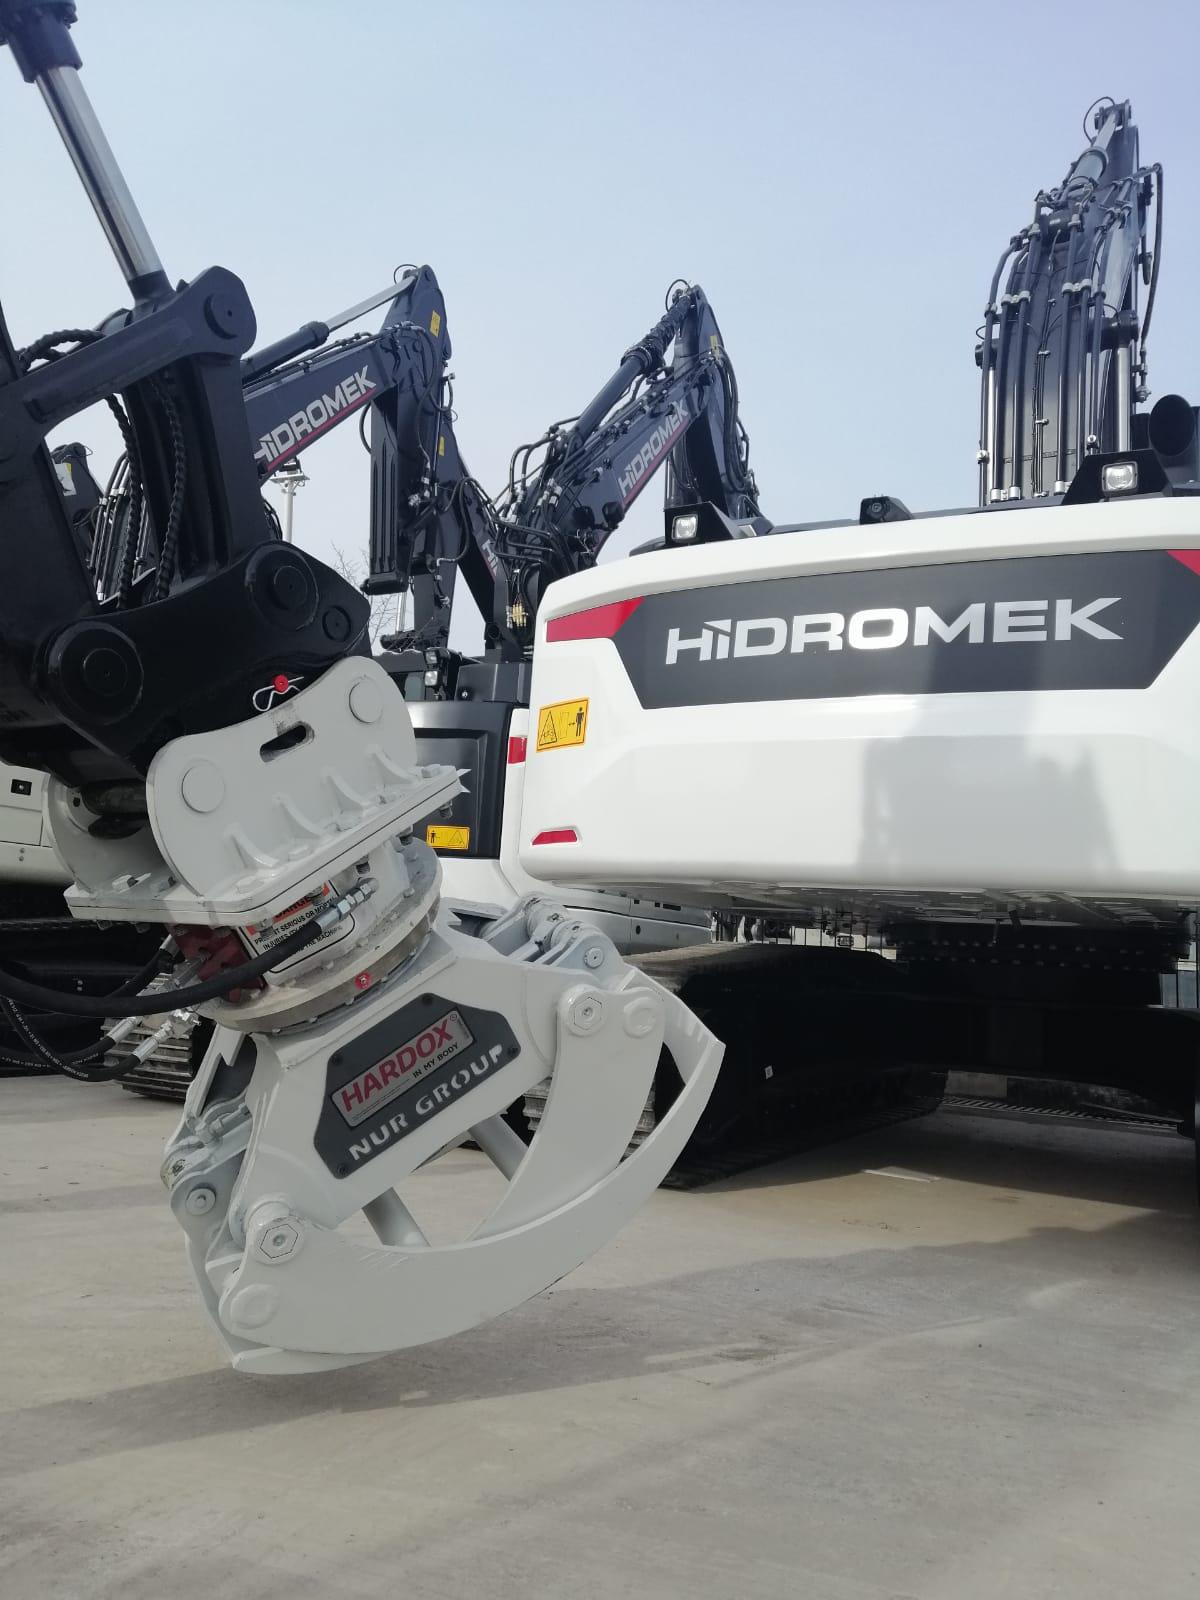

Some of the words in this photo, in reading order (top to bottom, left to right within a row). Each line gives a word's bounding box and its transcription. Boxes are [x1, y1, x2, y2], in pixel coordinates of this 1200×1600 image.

[305, 908, 315, 920] OR
[340, 1018, 454, 1112] HARDOX
[412, 1069, 423, 1079] IN
[423, 1058, 436, 1071] MY
[437, 1043, 459, 1065] BODY
[348, 1113, 409, 1160] NUR
[415, 1044, 503, 1116] GROUP
